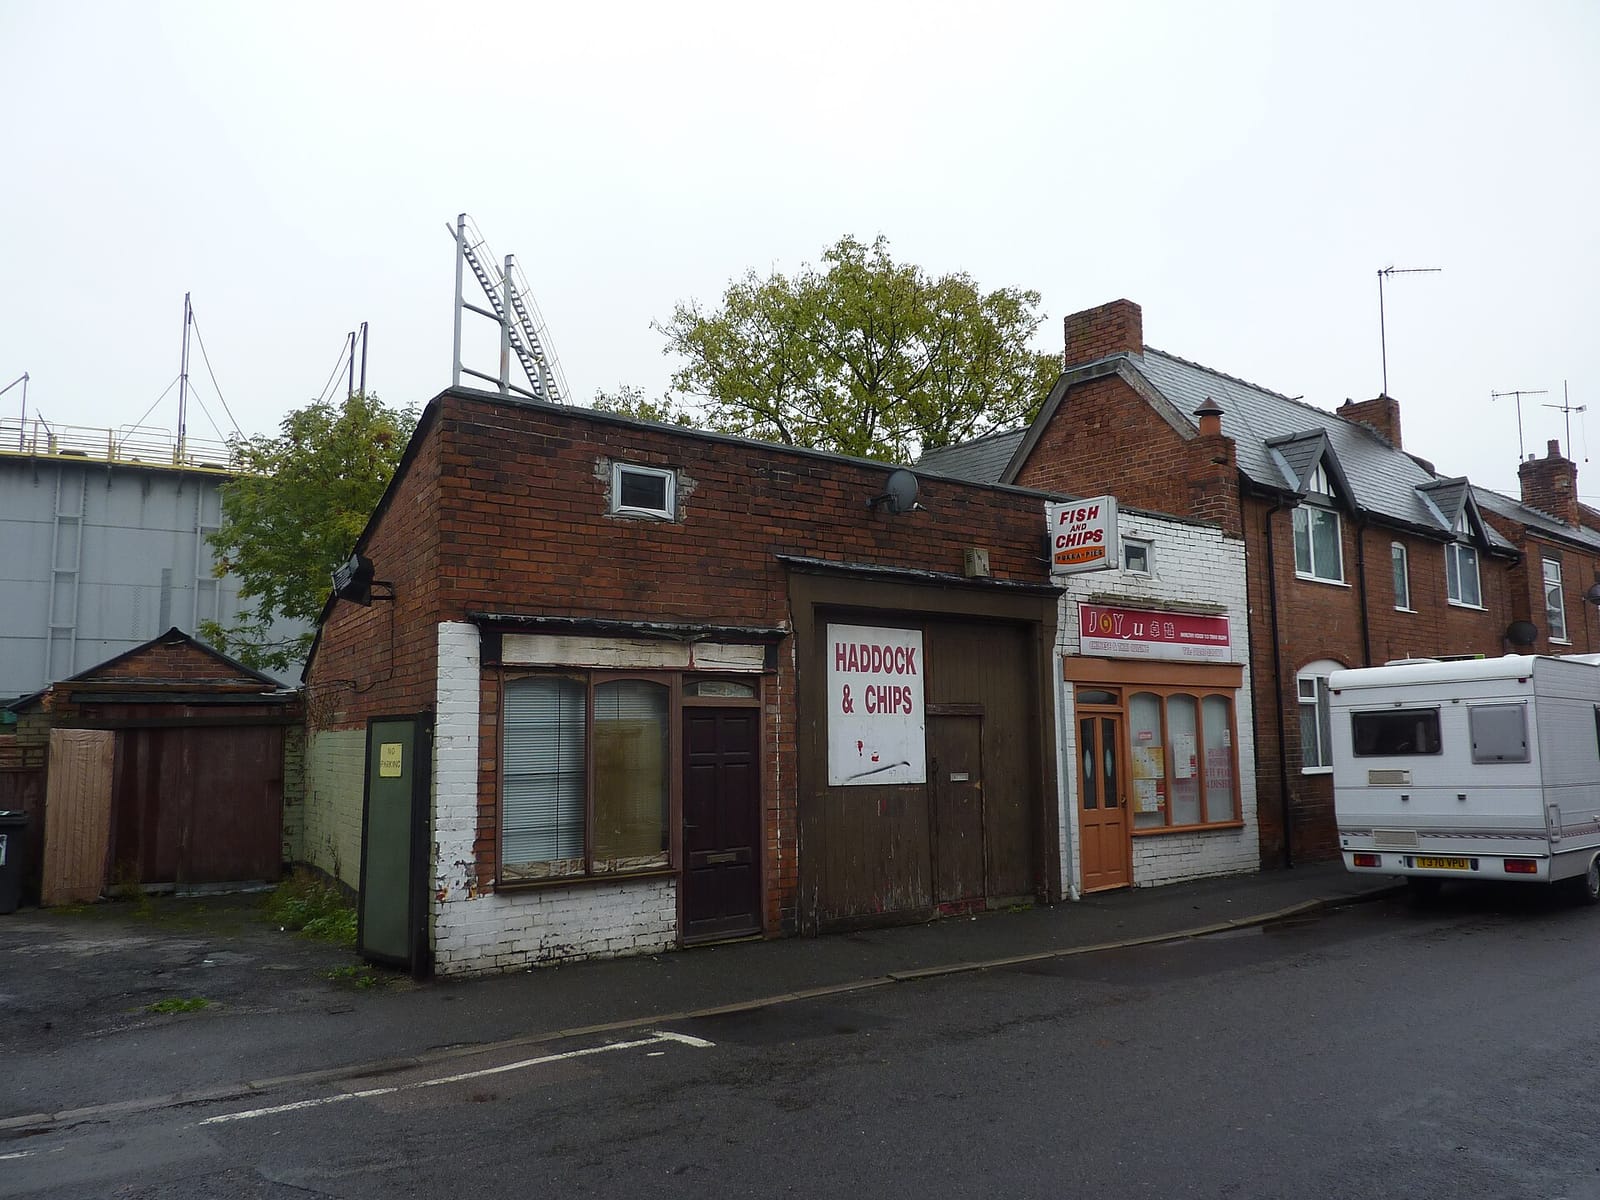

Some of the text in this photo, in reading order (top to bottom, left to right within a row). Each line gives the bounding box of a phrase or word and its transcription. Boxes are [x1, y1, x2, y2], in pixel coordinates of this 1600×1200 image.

[1059, 505, 1100, 525] FISH
[1069, 522, 1087, 533] AND
[1055, 528, 1104, 549] CHIPS
[835, 642, 917, 675] HADDOCK
[842, 683, 913, 715] & CHIPS
